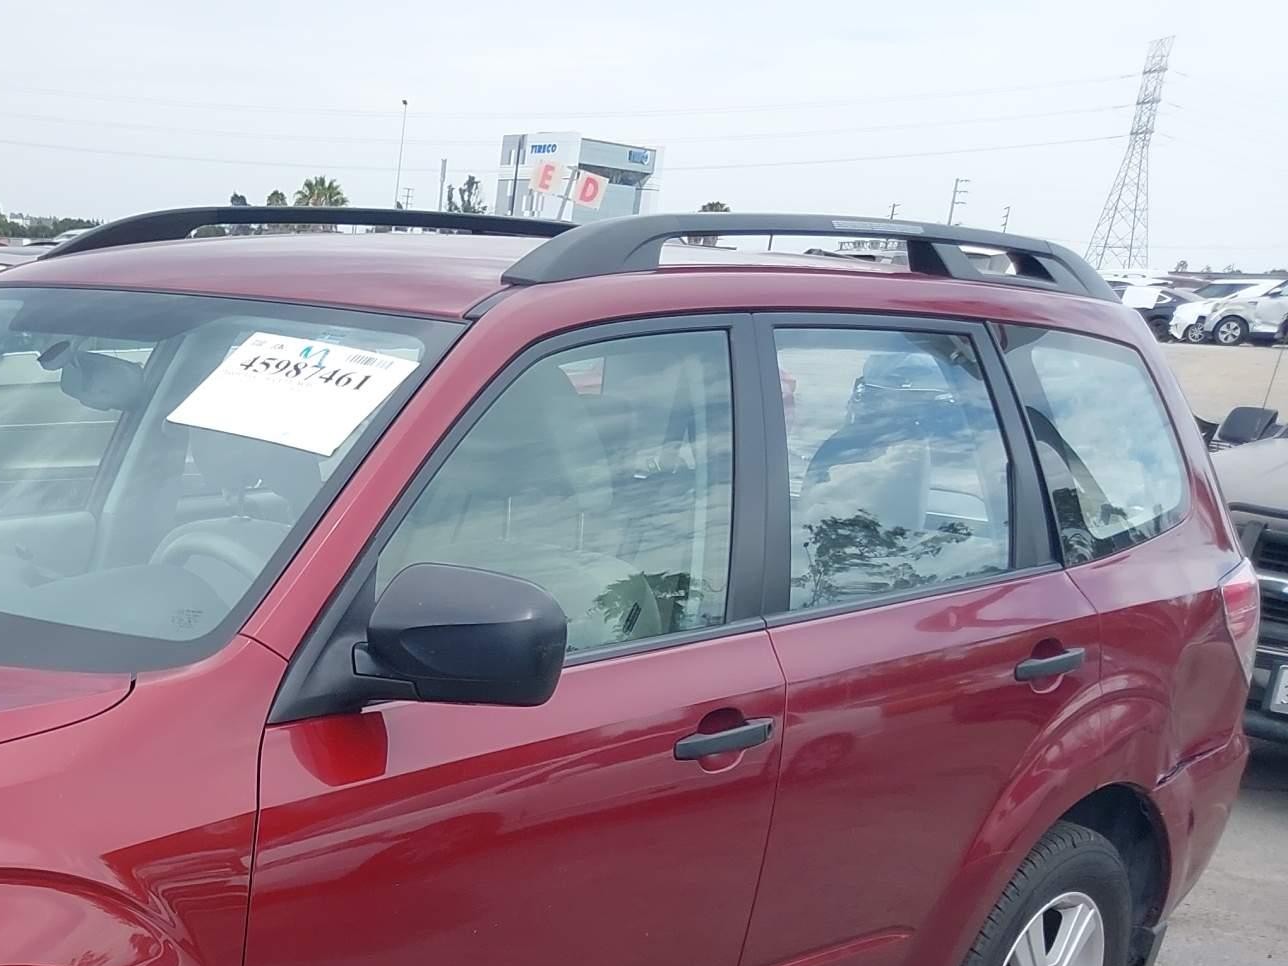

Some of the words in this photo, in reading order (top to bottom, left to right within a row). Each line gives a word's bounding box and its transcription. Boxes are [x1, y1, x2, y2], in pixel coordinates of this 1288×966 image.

[530, 144, 557, 154] TIRECO
[539, 164, 555, 189] E
[579, 176, 599, 202] D
[240, 355, 373, 391] 45987461
